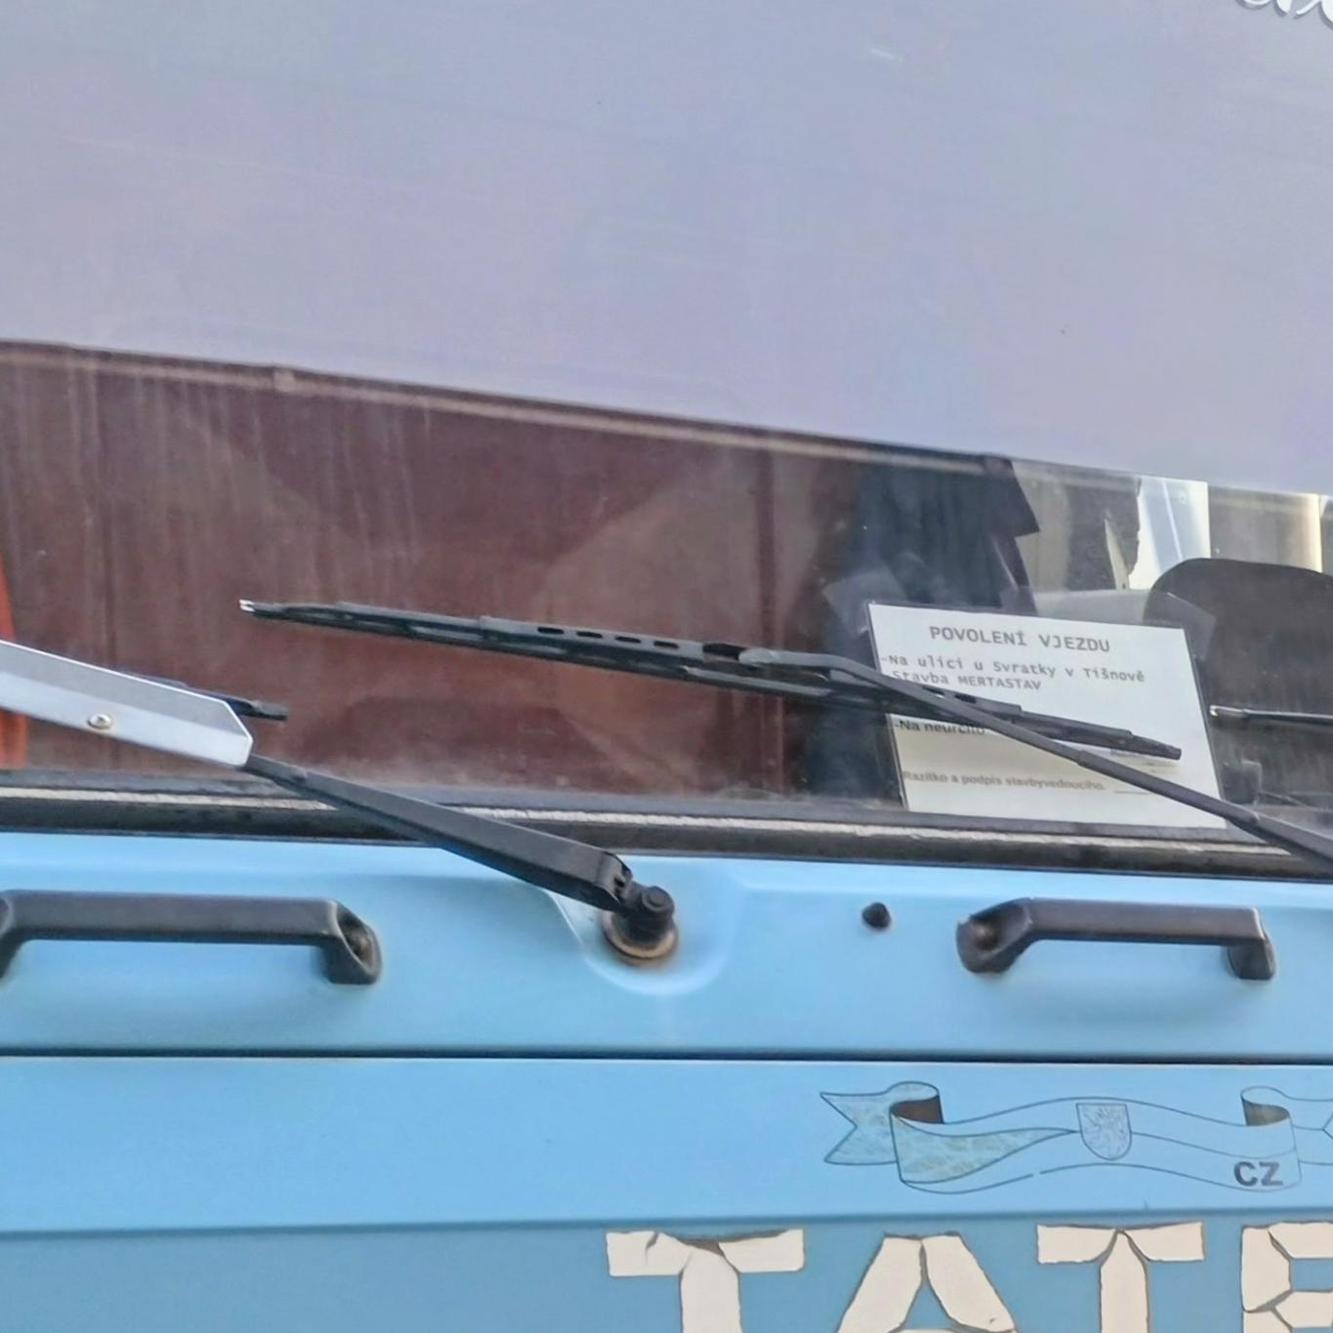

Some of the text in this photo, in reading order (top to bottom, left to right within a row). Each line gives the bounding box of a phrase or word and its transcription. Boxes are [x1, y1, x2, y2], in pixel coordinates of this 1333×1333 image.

[928, 625, 1111, 653] POVOLENÍ VJEZDU
[974, 660, 984, 671] u
[992, 661, 1057, 678] Svratky
[1065, 667, 1075, 677] v
[1233, 1161, 1284, 1187] CZ
